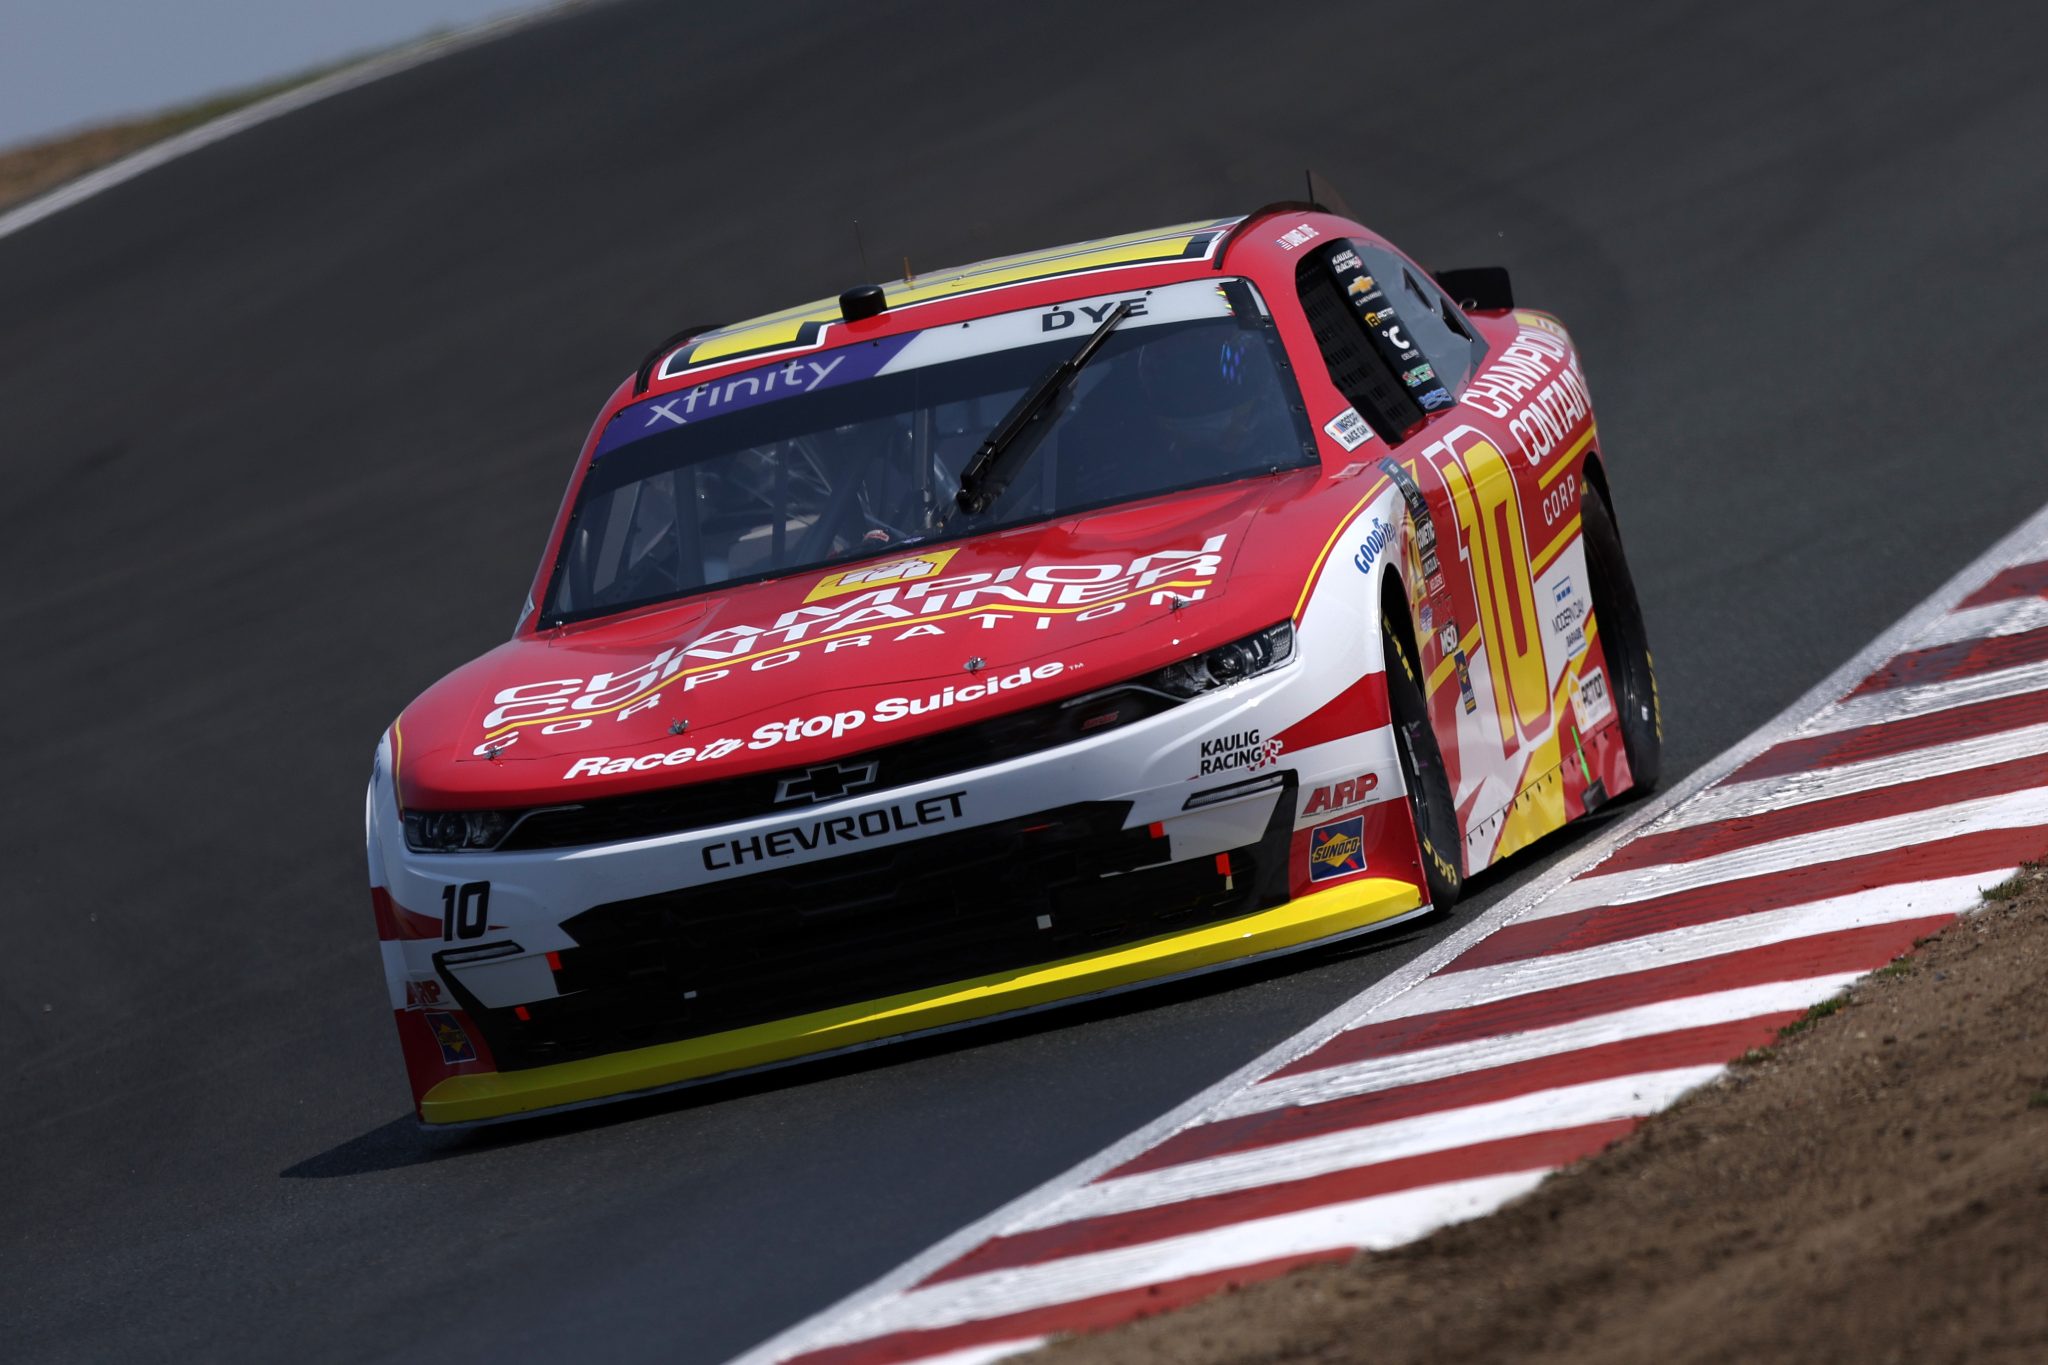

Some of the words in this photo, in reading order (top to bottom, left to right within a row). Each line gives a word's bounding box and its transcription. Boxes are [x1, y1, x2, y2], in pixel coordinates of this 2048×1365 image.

[1041, 296, 1149, 333] DYE
[645, 355, 846, 428] xfinity
[1459, 328, 1565, 419] CHAMPION
[1343, 429, 1360, 444] RACE
[1541, 473, 1576, 527] CORP
[494, 533, 1228, 705] CHAMPION
[1430, 432, 1552, 755] 10
[472, 588, 1206, 756] CORPORATION
[482, 554, 1222, 729] CONTAINER
[562, 747, 697, 780] Race
[695, 736, 746, 764] to
[747, 709, 867, 751] Stop
[872, 661, 1065, 724] Suicide
[1200, 728, 1260, 758] KAULIG
[1200, 747, 1263, 776] RACING
[1302, 772, 1379, 815] ARP
[701, 790, 967, 871] CHEVROLET
[1314, 838, 1359, 861] SUNOCO
[441, 880, 491, 942] 10
